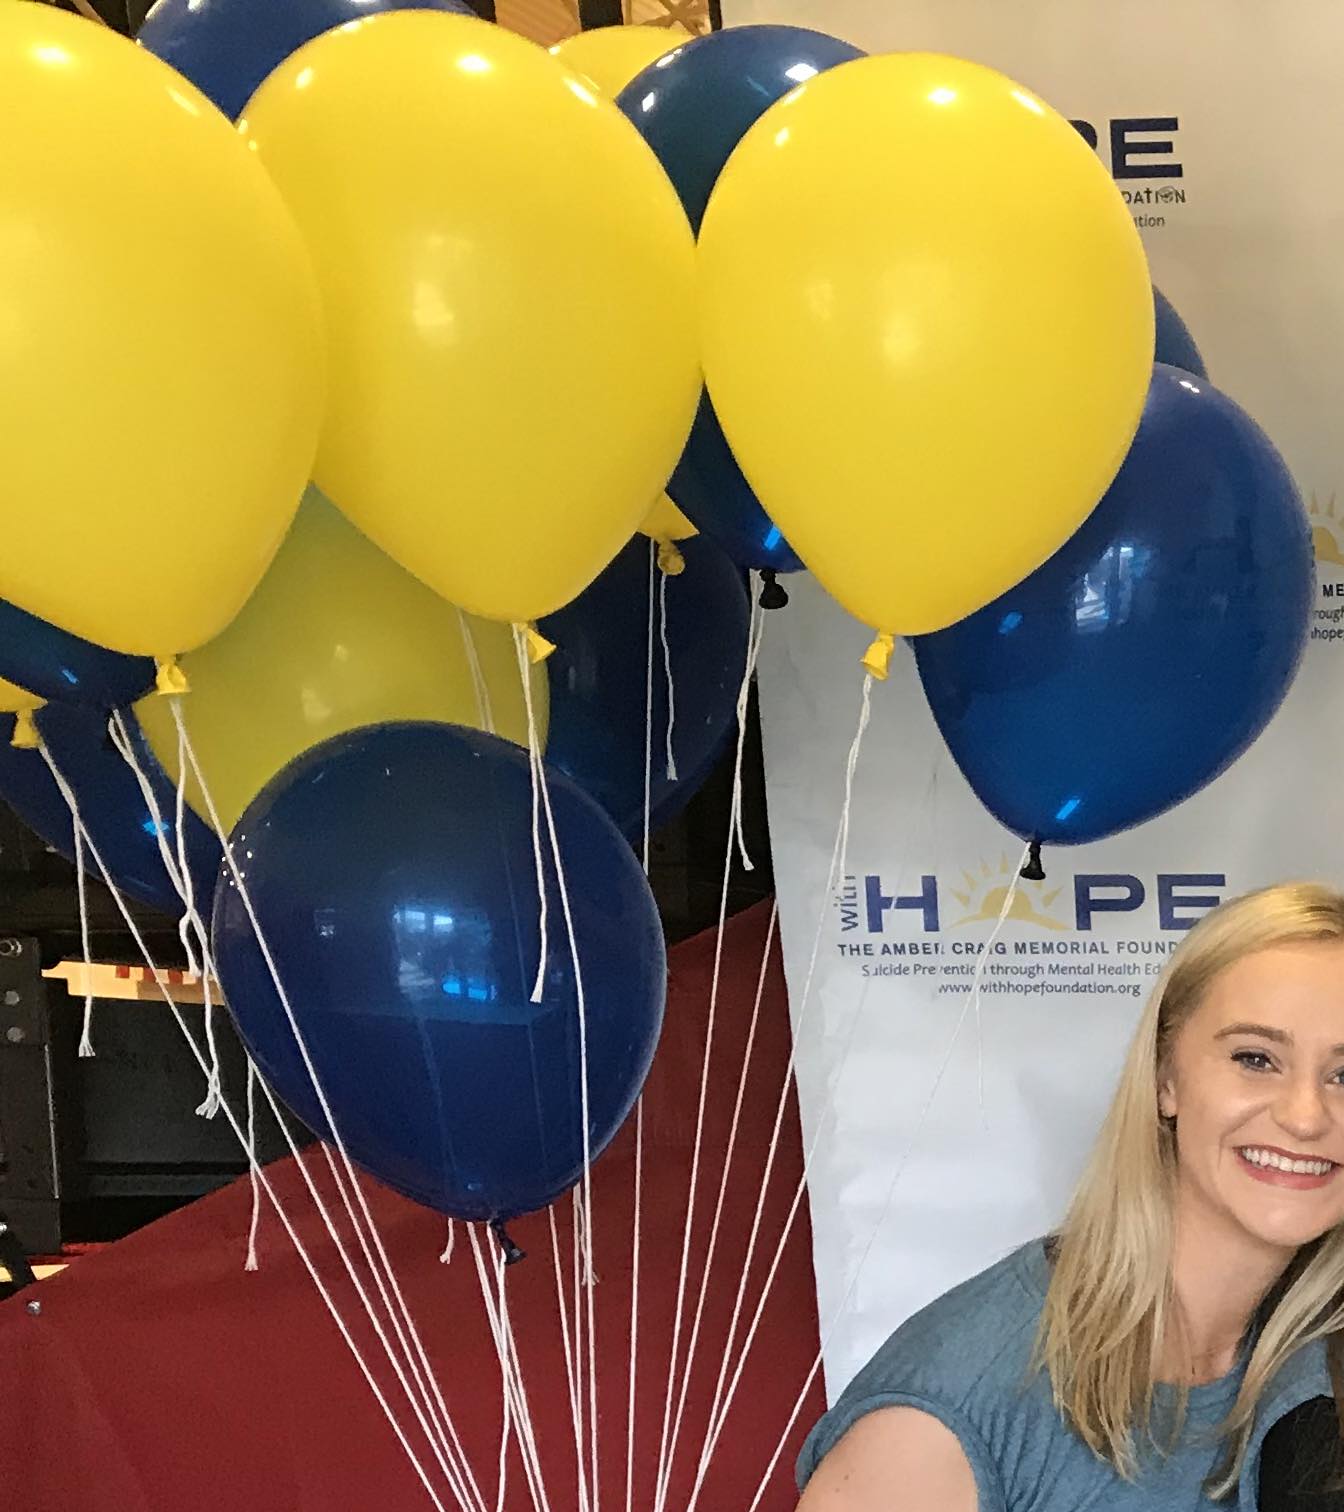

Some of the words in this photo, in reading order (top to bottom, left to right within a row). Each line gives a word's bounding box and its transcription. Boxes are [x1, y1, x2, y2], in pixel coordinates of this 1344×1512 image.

[837, 944, 874, 956] THE
[1014, 942, 1109, 954] MEMORIAL
[990, 964, 1044, 979] through
[1048, 963, 1094, 975] Mental
[1098, 963, 1140, 976] Health
[939, 981, 1141, 997] wwwwithhopefoundation.org
